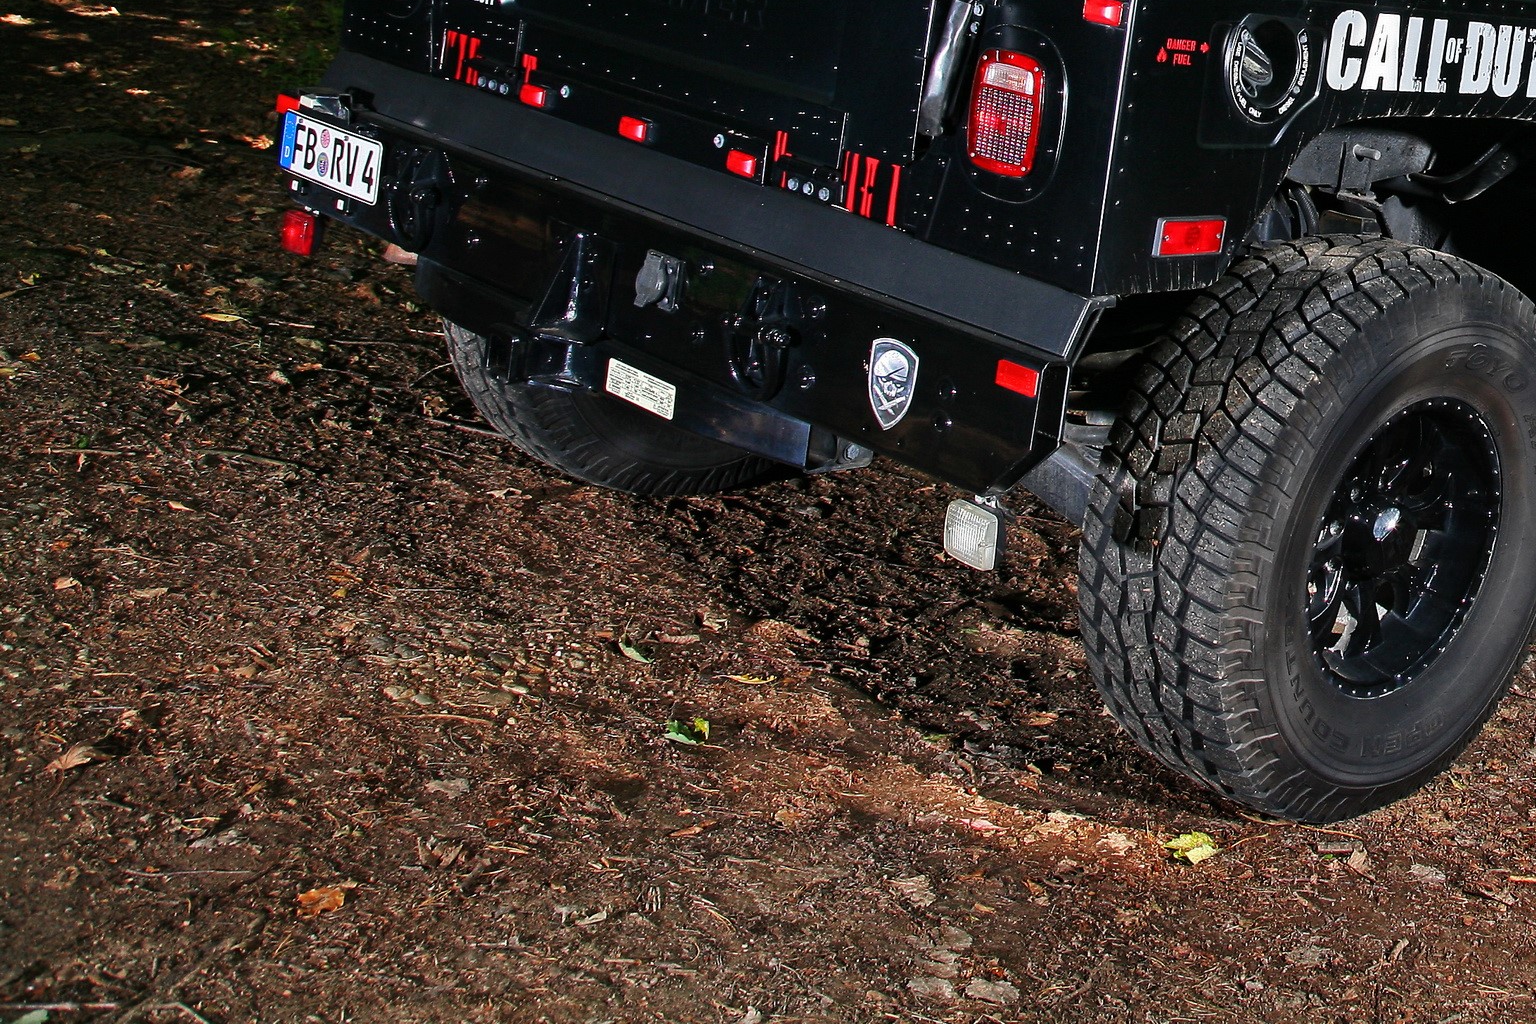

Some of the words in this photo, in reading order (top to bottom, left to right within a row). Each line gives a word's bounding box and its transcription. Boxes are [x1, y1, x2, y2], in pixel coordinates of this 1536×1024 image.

[1166, 37, 1197, 52] DANGER
[1325, 9, 1449, 93] CALL
[1445, 37, 1465, 64] OF
[1173, 53, 1192, 67] FUEL
[284, 145, 291, 158] D
[291, 123, 318, 170] FB
[329, 137, 360, 188] RV
[361, 149, 374, 194] 4
